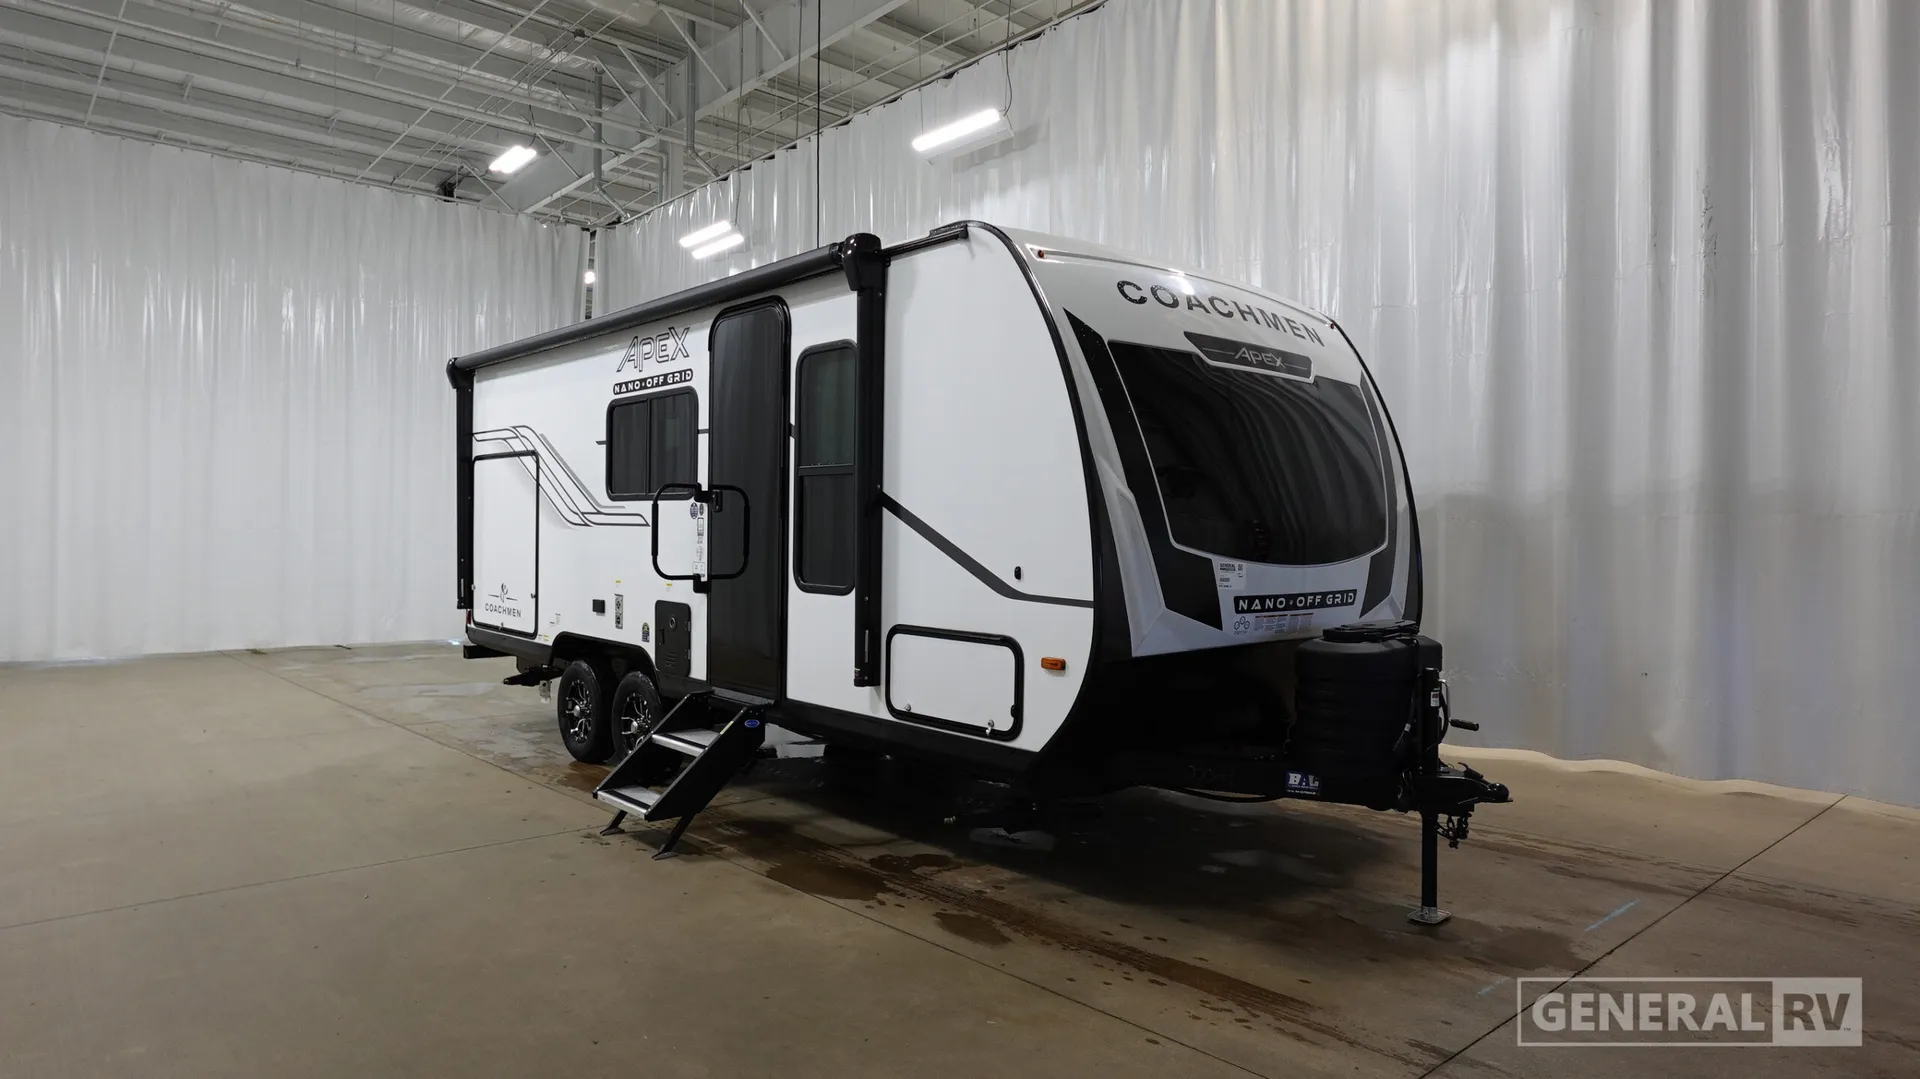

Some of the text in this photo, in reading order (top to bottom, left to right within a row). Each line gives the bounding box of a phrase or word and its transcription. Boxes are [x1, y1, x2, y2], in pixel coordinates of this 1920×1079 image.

[1116, 280, 1325, 347] COACHMEN
[614, 370, 692, 394] NANO OFF GRID
[485, 602, 522, 618] COACHMEN
[1238, 592, 1354, 611] NANO OFF GRID
